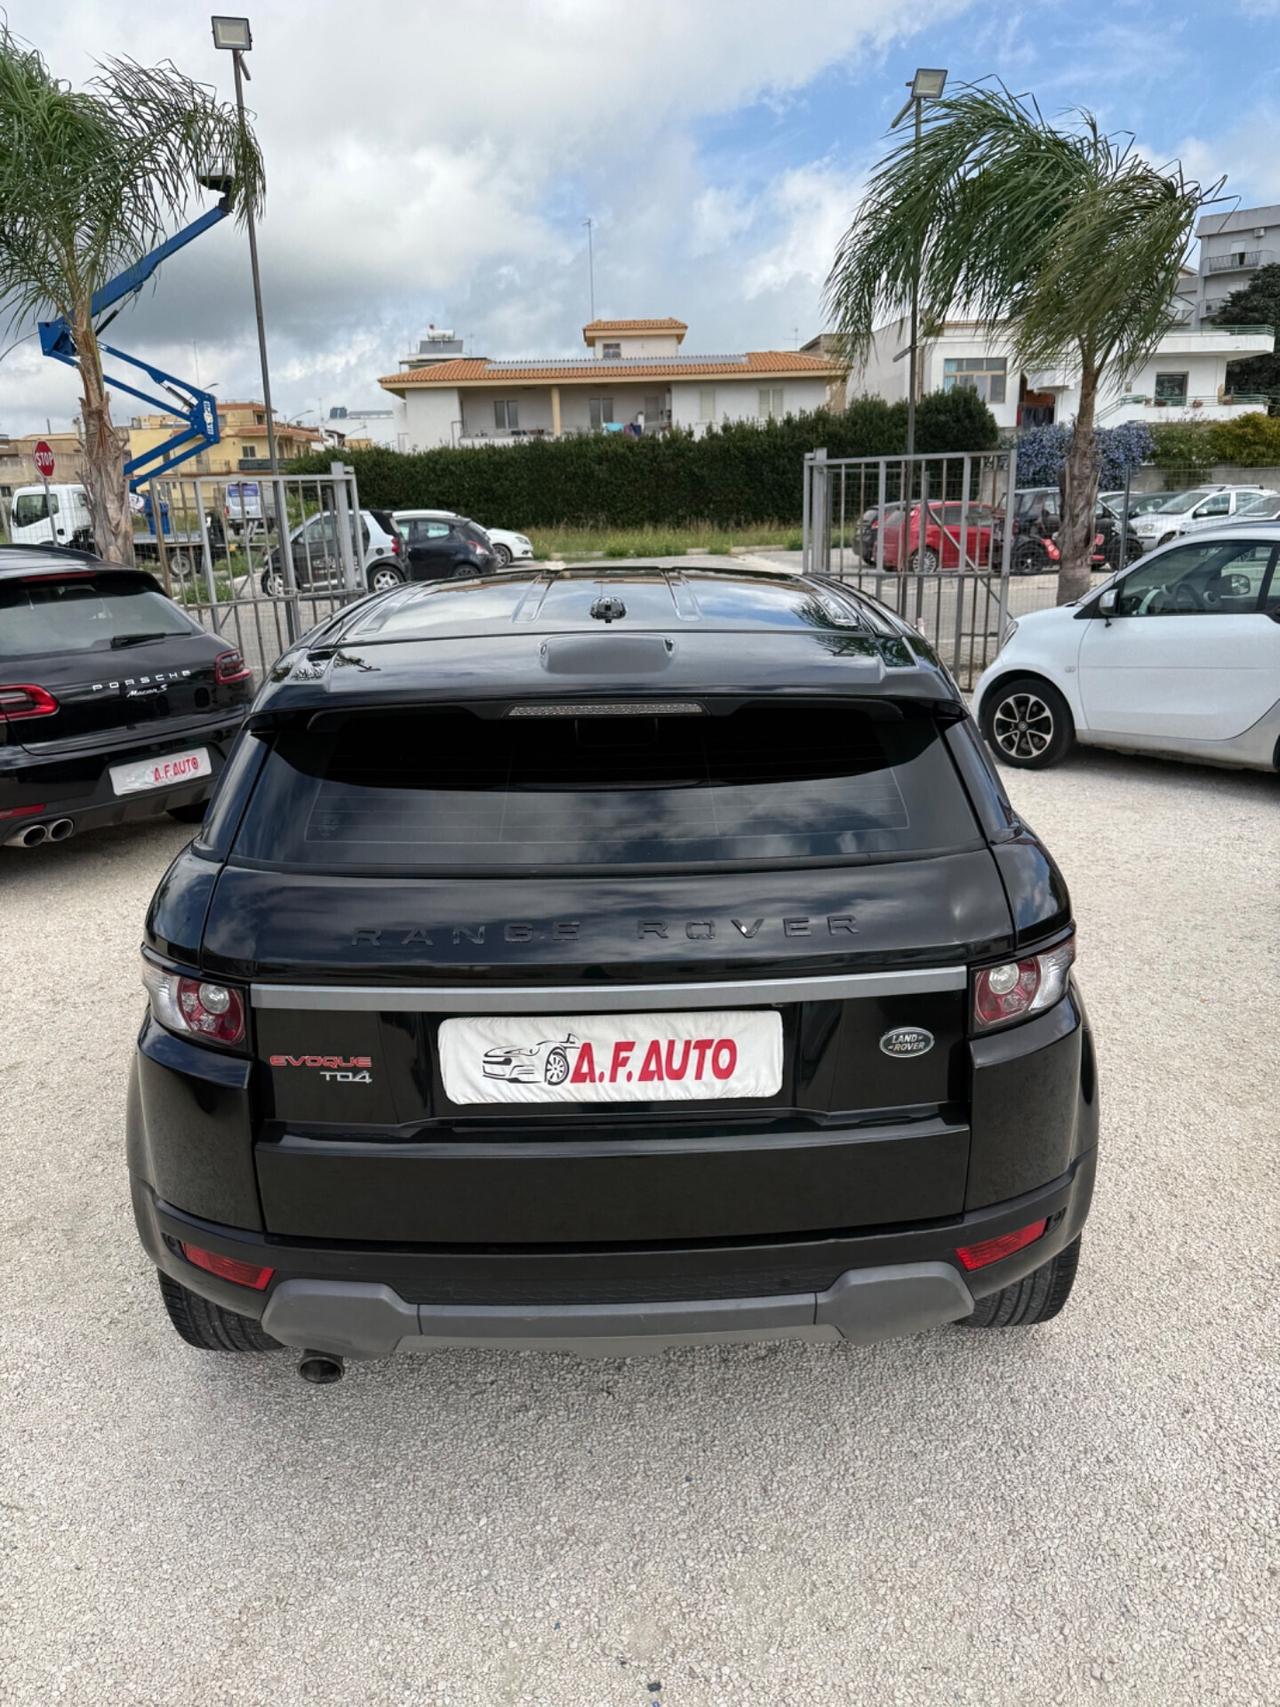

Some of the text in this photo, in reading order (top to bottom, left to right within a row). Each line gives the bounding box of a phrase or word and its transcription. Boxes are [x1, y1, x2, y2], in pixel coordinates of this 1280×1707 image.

[35, 452, 54, 466] STOP
[92, 670, 191, 691] PORSCHE
[351, 914, 860, 947] RANGE ROVER
[270, 1055, 372, 1068] EVOQUE
[320, 1070, 373, 1083] TD4
